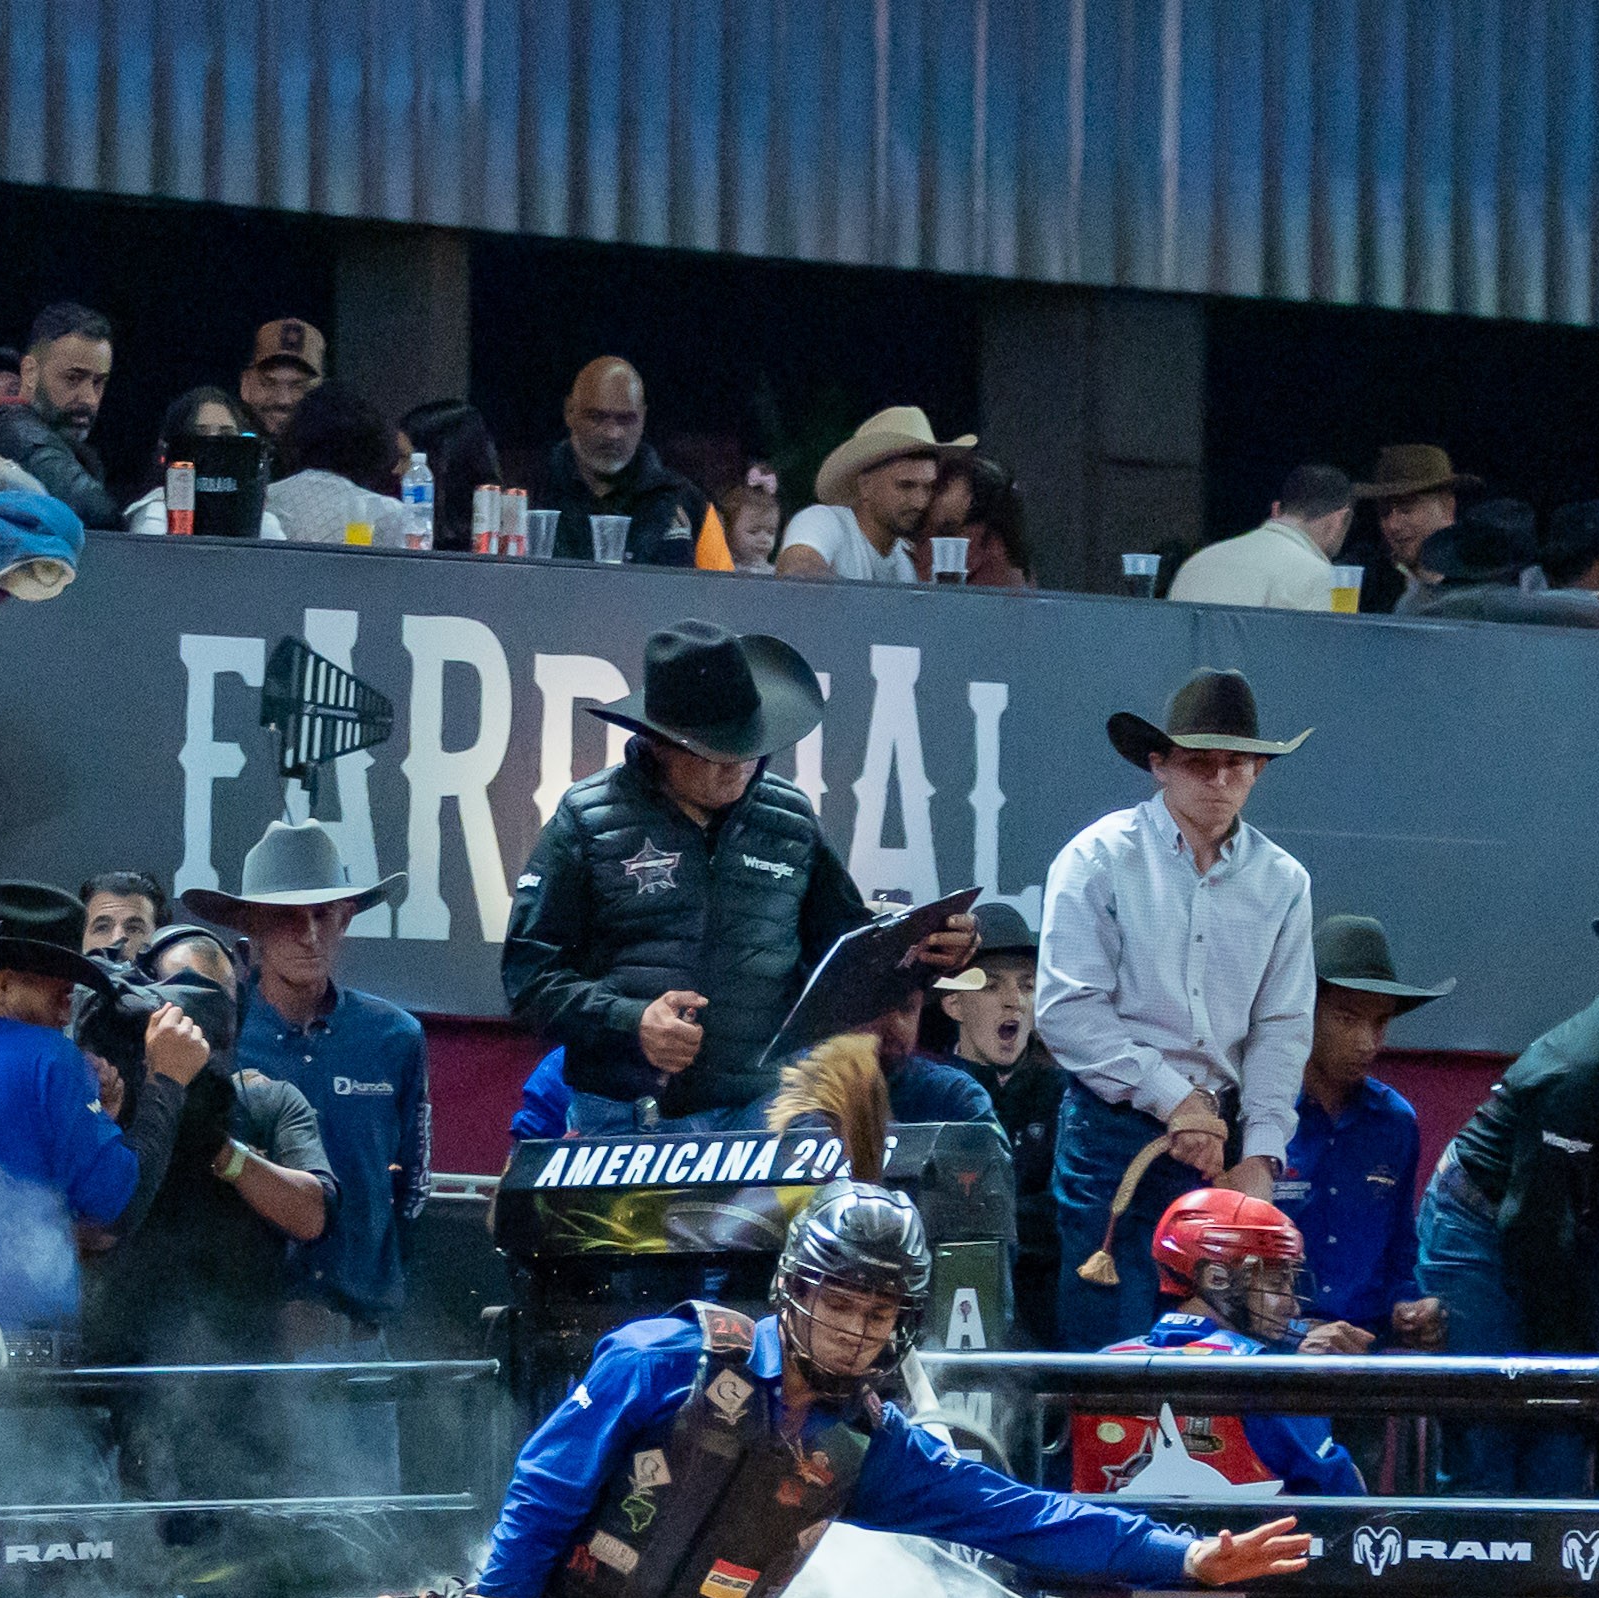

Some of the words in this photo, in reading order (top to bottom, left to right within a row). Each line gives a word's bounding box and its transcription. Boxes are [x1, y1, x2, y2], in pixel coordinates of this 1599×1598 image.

[534, 1138, 784, 1189] AMERICANA
[5, 1541, 114, 1563] RAM
[1407, 1538, 1533, 1562] RAM
